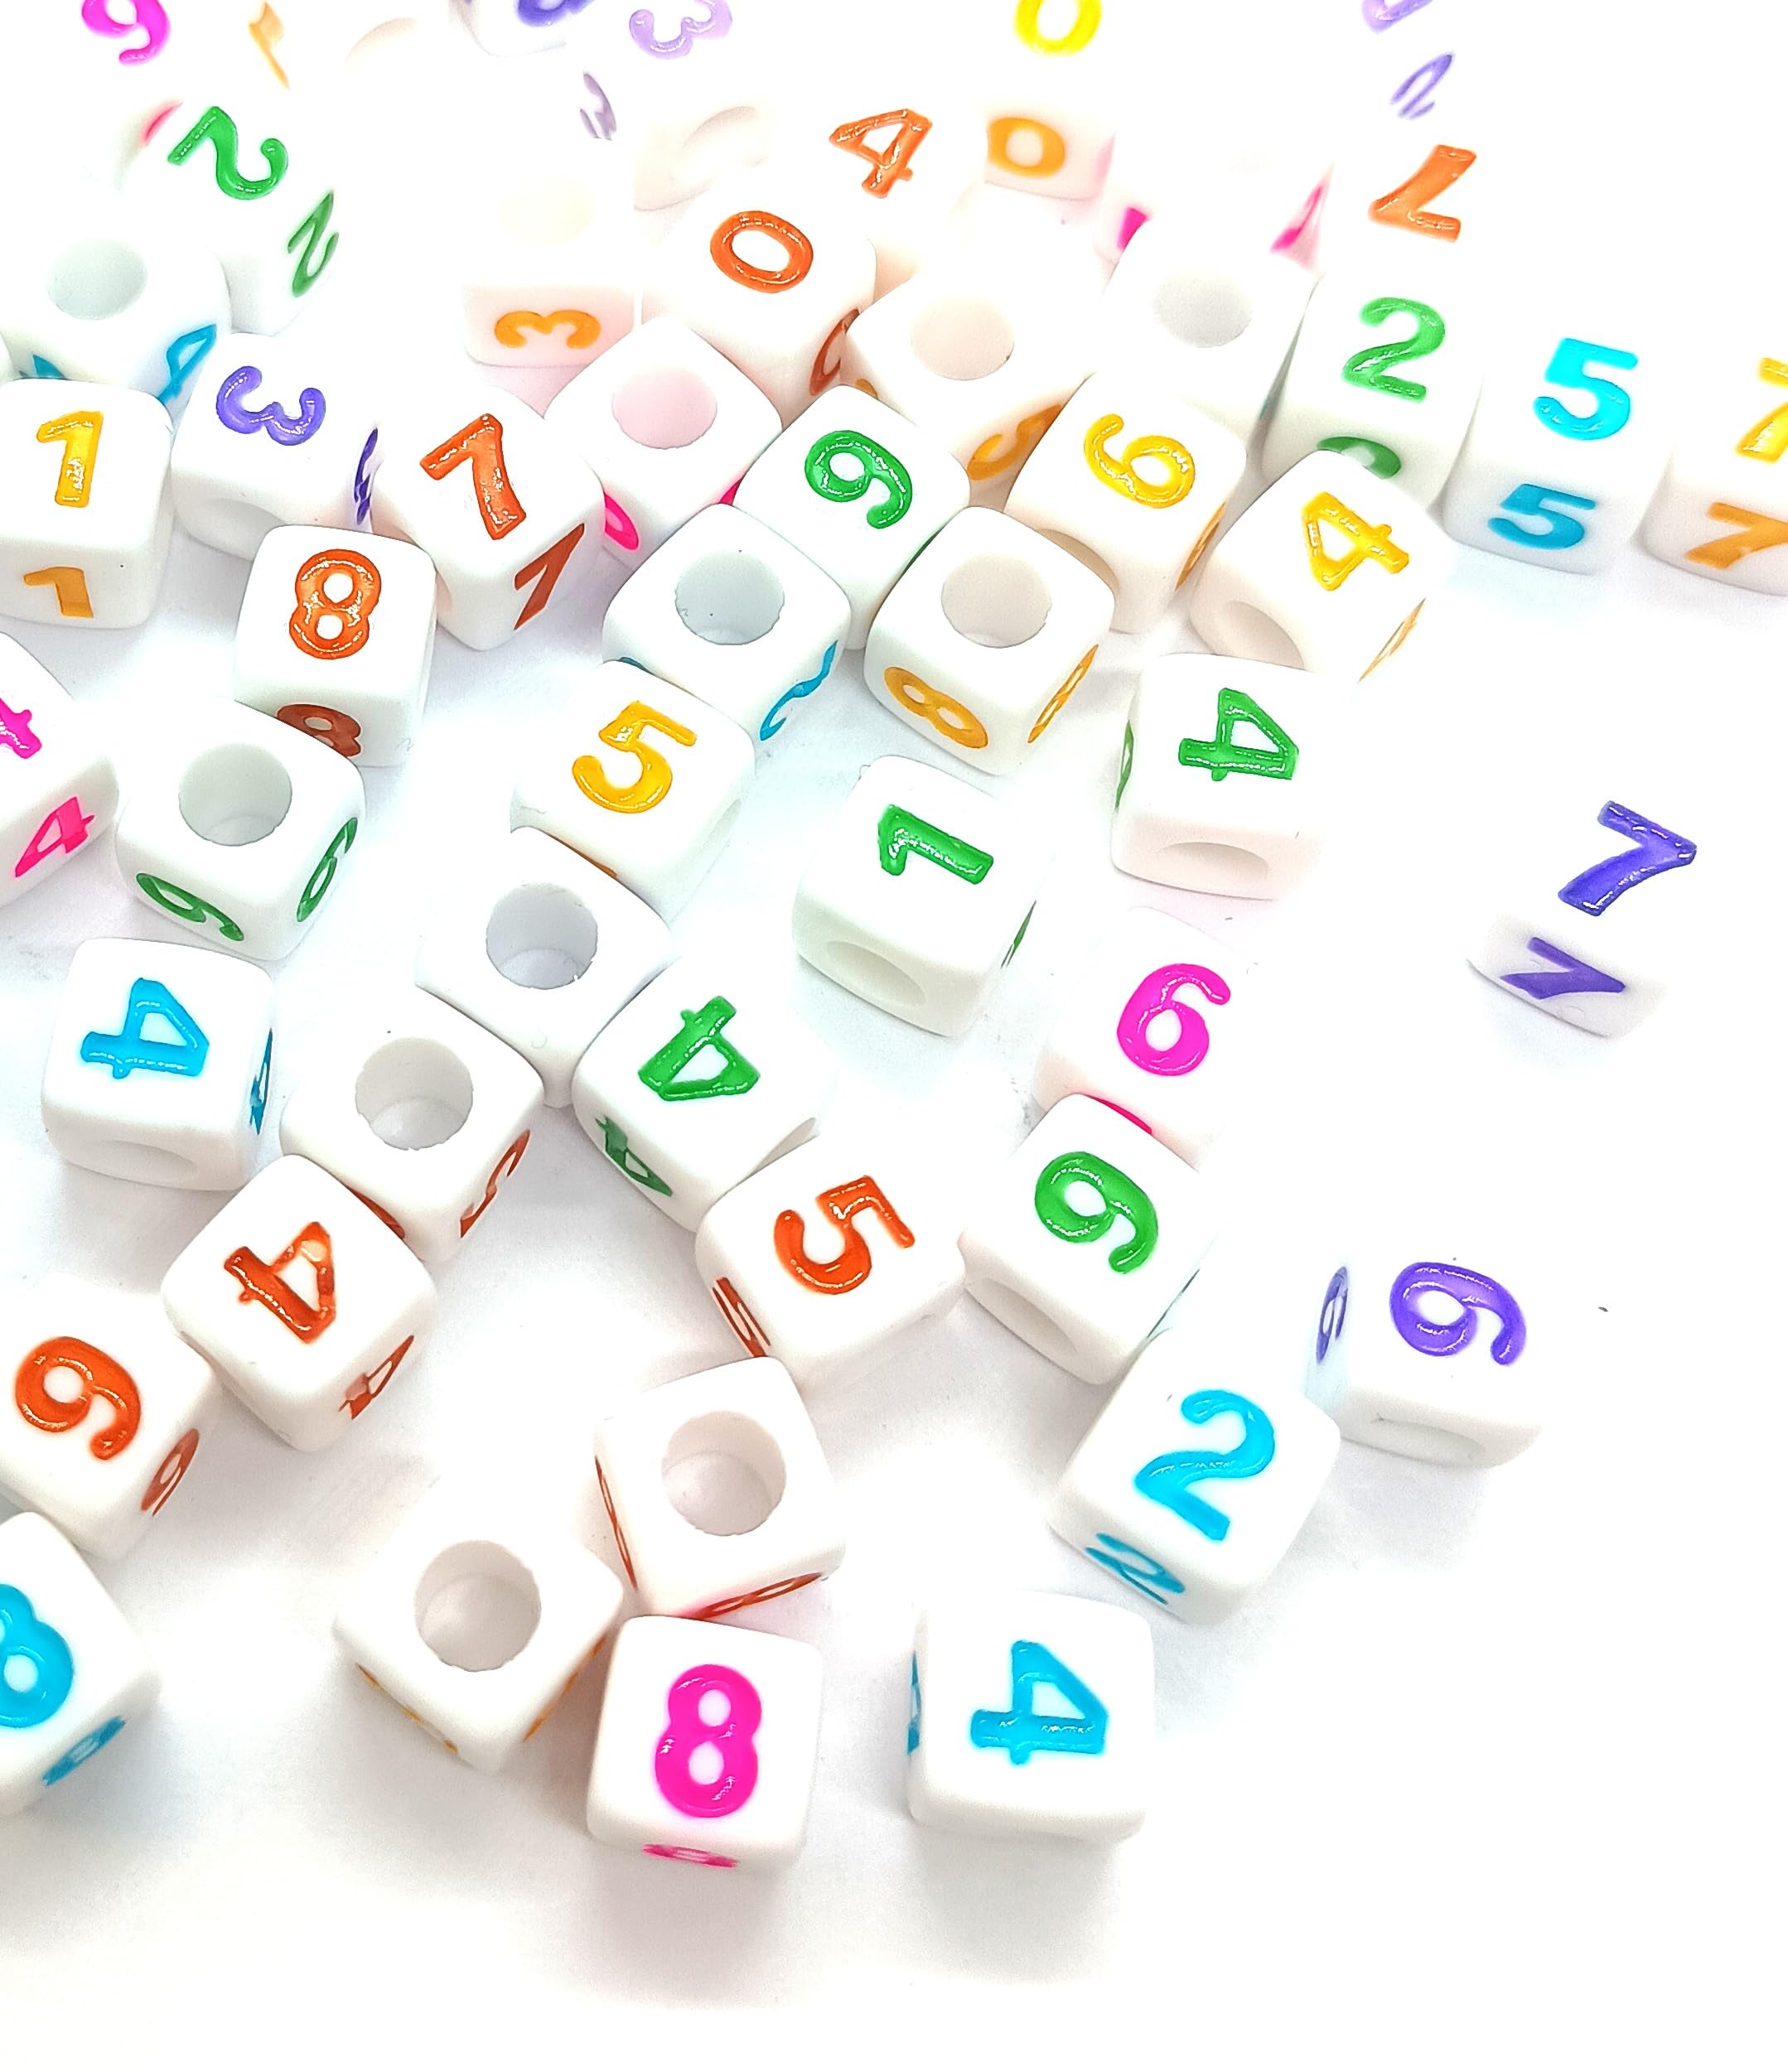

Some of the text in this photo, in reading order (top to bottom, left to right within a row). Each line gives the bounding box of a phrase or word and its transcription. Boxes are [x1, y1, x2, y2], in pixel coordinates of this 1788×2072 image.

[167, 106, 287, 200] 2
[829, 109, 932, 198] 4
[988, 115, 1068, 178] 0
[1370, 145, 1476, 242] 7
[710, 210, 814, 293] 0
[493, 308, 602, 350] 3
[1343, 297, 1445, 402] 2
[216, 366, 325, 446] 3
[1533, 337, 1639, 441] 5
[36, 410, 104, 508] 1
[419, 413, 526, 540] 7
[1301, 491, 1410, 592] 4
[1488, 483, 1597, 550] 5
[1684, 501, 1788, 570] 7
[289, 548, 381, 660] 8
[572, 700, 697, 814] 5
[884, 667, 988, 750] 8
[1178, 688, 1299, 781] 4
[12, 796, 97, 878] 4
[877, 804, 993, 885] 1
[1558, 801, 1696, 916] 7
[1503, 936, 1626, 999] 7
[79, 978, 210, 1080] 4
[637, 997, 759, 1102] 4
[1117, 964, 1231, 1076] 6
[223, 1222, 336, 1345] 4
[773, 1176, 916, 1295] 5
[337, 1335, 415, 1420] 4
[1132, 1389, 1276, 1543] 2
[654, 1664, 762, 1818] 8
[969, 1640, 1109, 1767] 4
